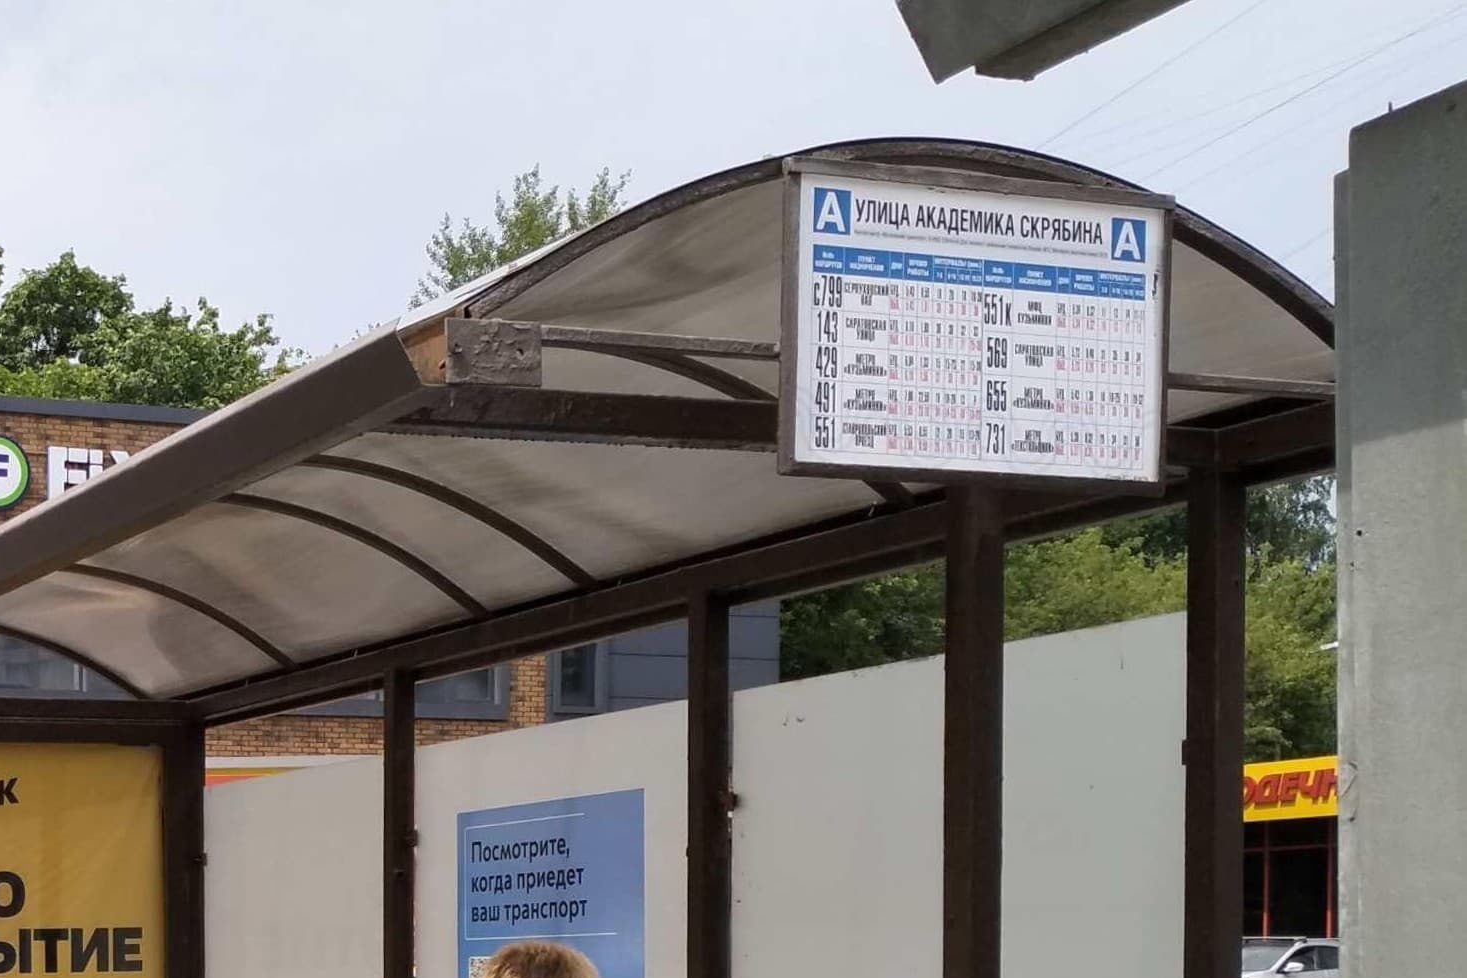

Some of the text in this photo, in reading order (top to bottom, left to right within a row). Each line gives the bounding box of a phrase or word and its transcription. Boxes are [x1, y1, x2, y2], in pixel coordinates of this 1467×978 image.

[816, 191, 846, 233] А
[854, 198, 911, 230] УЛИЦА
[915, 205, 1015, 237] АКАДЕМИКА
[1020, 215, 1103, 245] СКРЯБИНА
[1113, 221, 1142, 260] А
[813, 275, 843, 308] с799
[984, 293, 1012, 327] 551к
[817, 310, 838, 343] 143
[815, 346, 838, 378] 429
[986, 337, 1008, 368] 569
[815, 382, 836, 413] 491
[986, 380, 1007, 412] 655
[815, 416, 836, 448] 551
[986, 423, 1006, 454] 731
[471, 837, 570, 863] Посмотрите,
[471, 867, 585, 894] когда приедет
[471, 899, 588, 926] ваш транспорт
